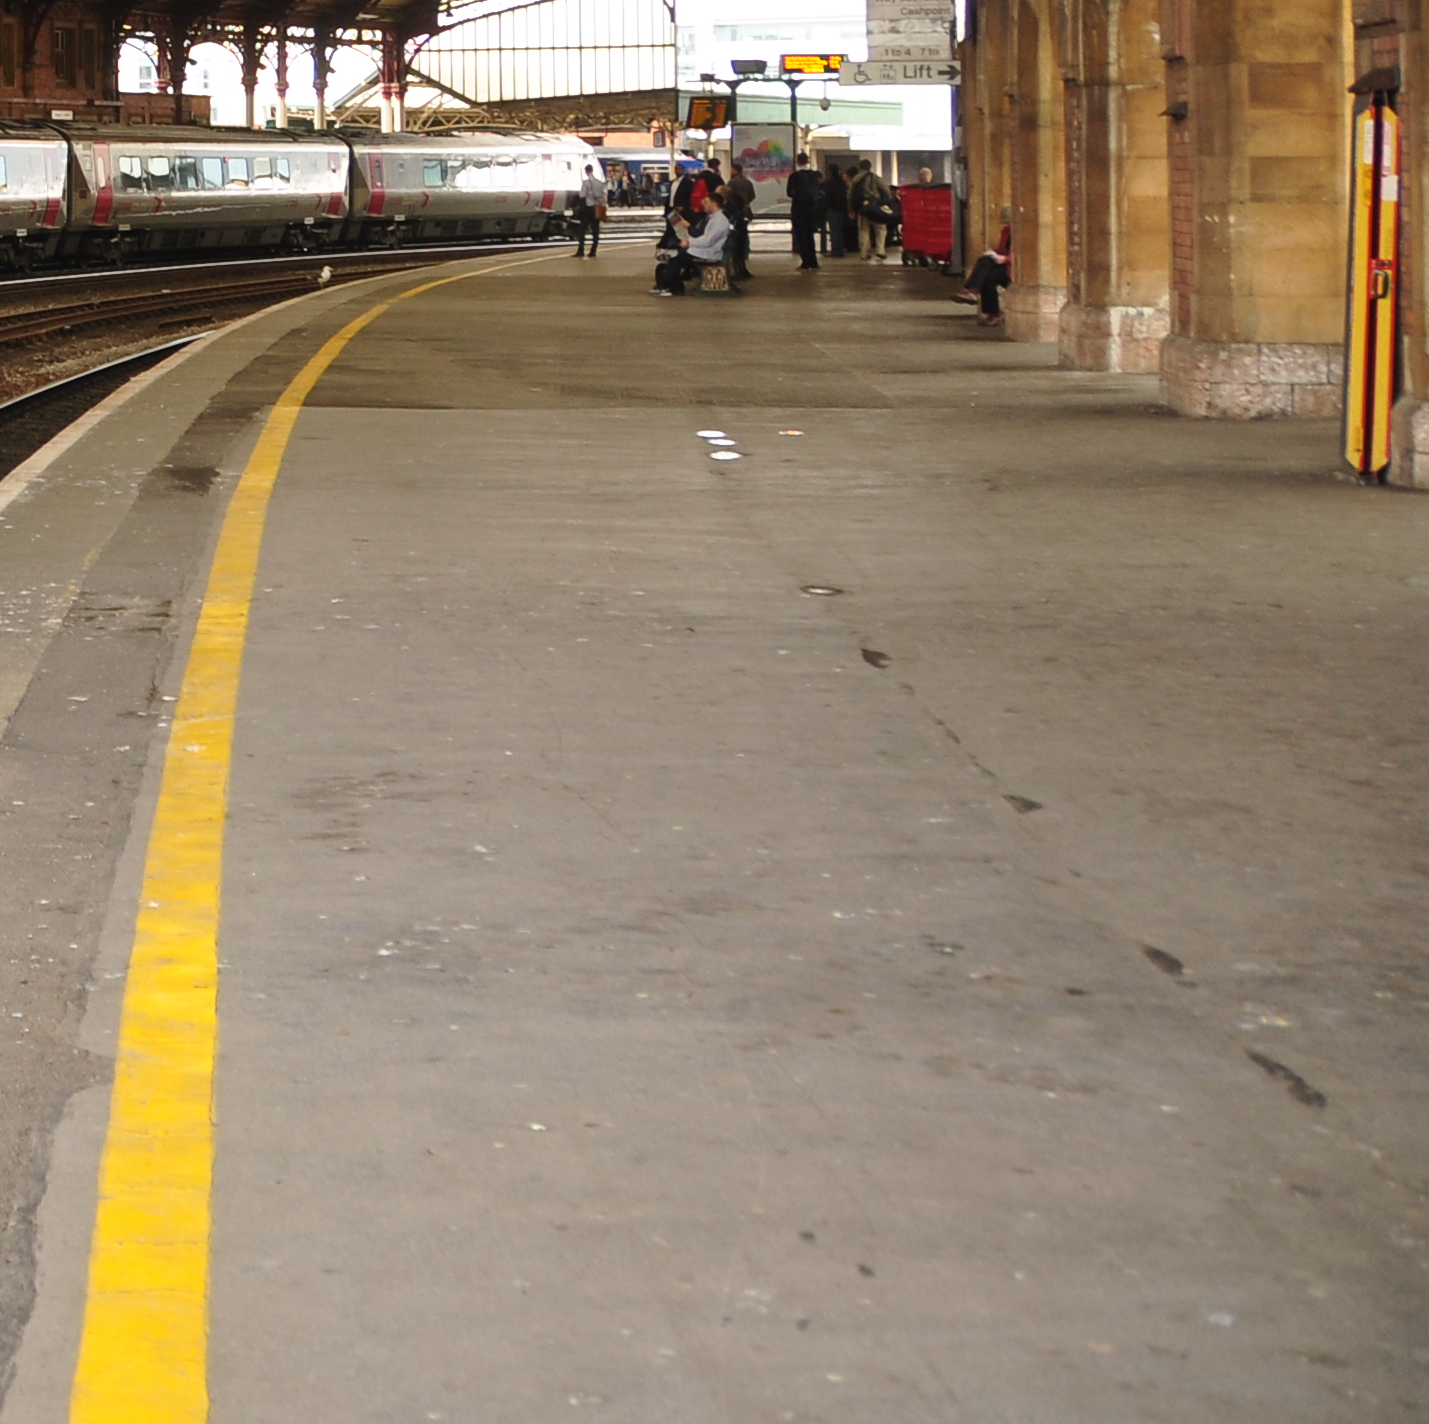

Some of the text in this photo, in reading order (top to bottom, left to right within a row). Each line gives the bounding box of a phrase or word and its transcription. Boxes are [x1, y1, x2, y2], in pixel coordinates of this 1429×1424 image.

[901, 7, 951, 16] Cashpoint
[891, 48, 901, 56] to
[904, 48, 911, 56] 4
[928, 48, 939, 56] to
[903, 64, 933, 79] Lift
